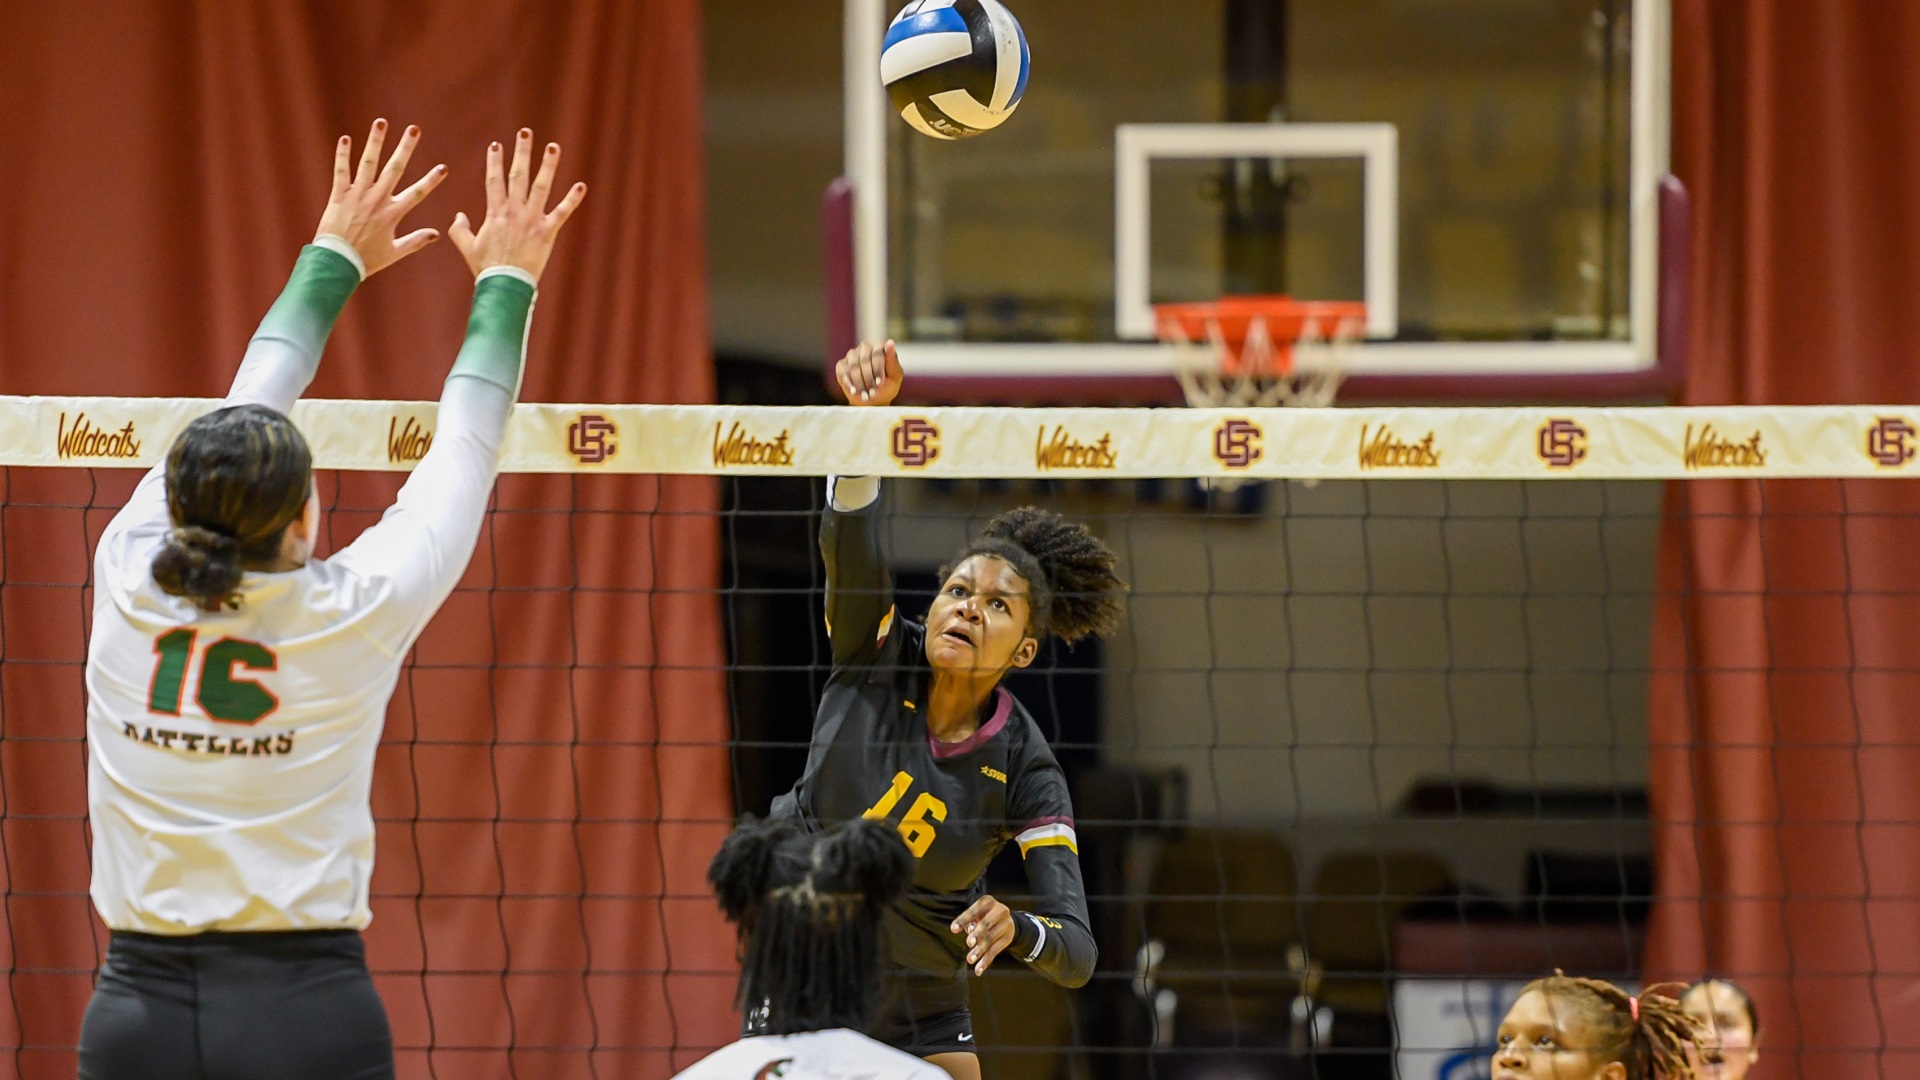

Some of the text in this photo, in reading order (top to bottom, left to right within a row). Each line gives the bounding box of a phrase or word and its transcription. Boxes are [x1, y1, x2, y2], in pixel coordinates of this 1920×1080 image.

[57, 412, 141, 459] Wildcats
[713, 421, 793, 468] Wildcats
[1037, 425, 1117, 469] Wildcats
[1359, 424, 1439, 468] Wildcats
[1684, 423, 1766, 468] Wildcats
[148, 626, 279, 726] 16
[862, 771, 947, 857] 16
